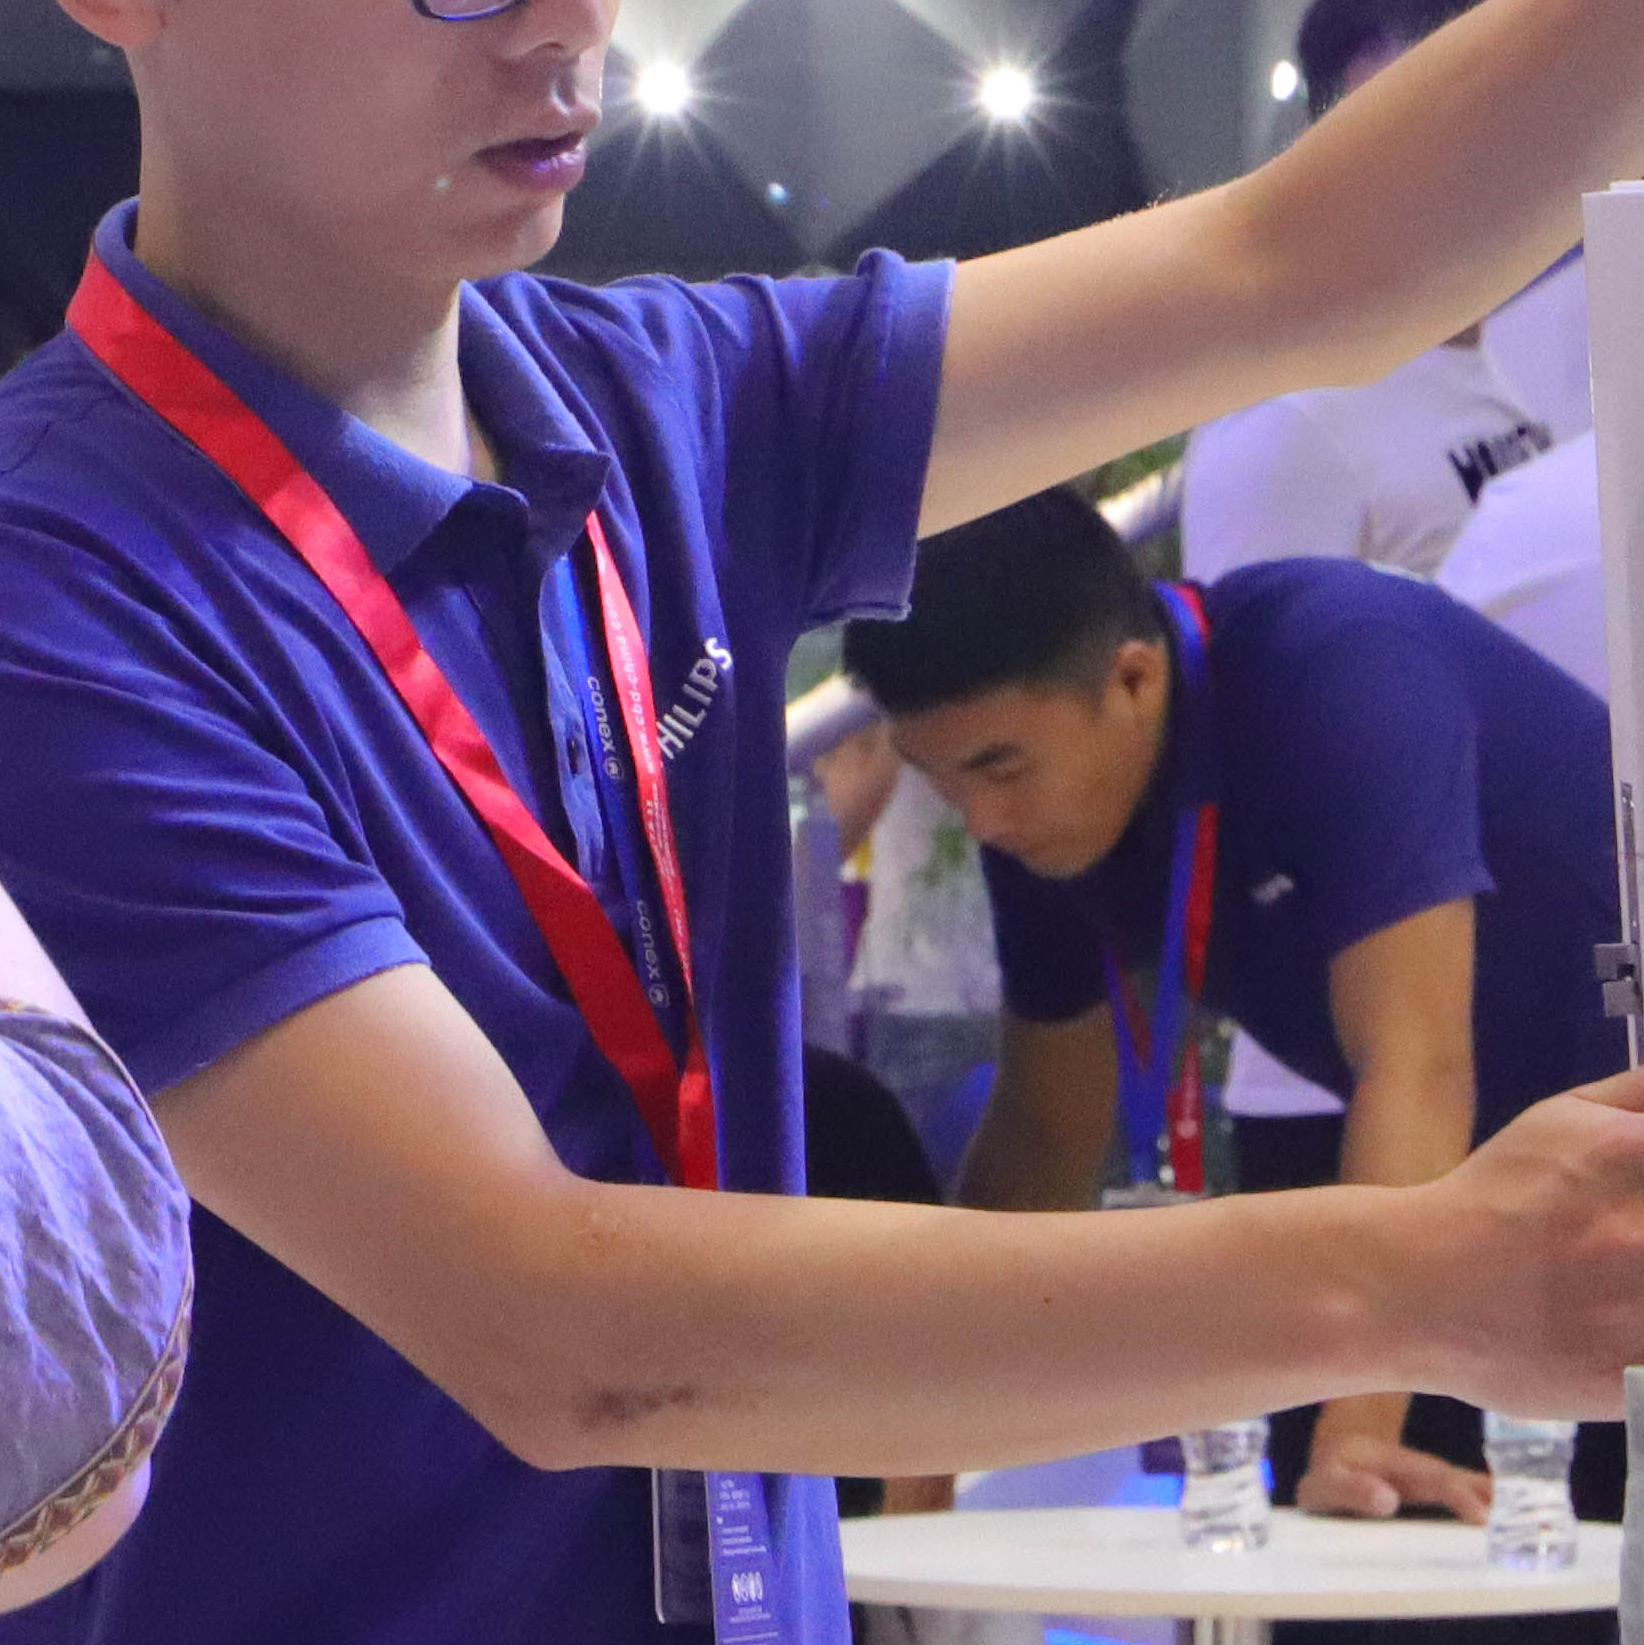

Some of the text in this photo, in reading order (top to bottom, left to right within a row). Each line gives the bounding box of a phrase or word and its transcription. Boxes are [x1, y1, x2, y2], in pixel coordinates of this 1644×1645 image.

[586, 676, 617, 753] conex
[656, 636, 734, 761] HILIPS
[636, 899, 661, 980] conex
